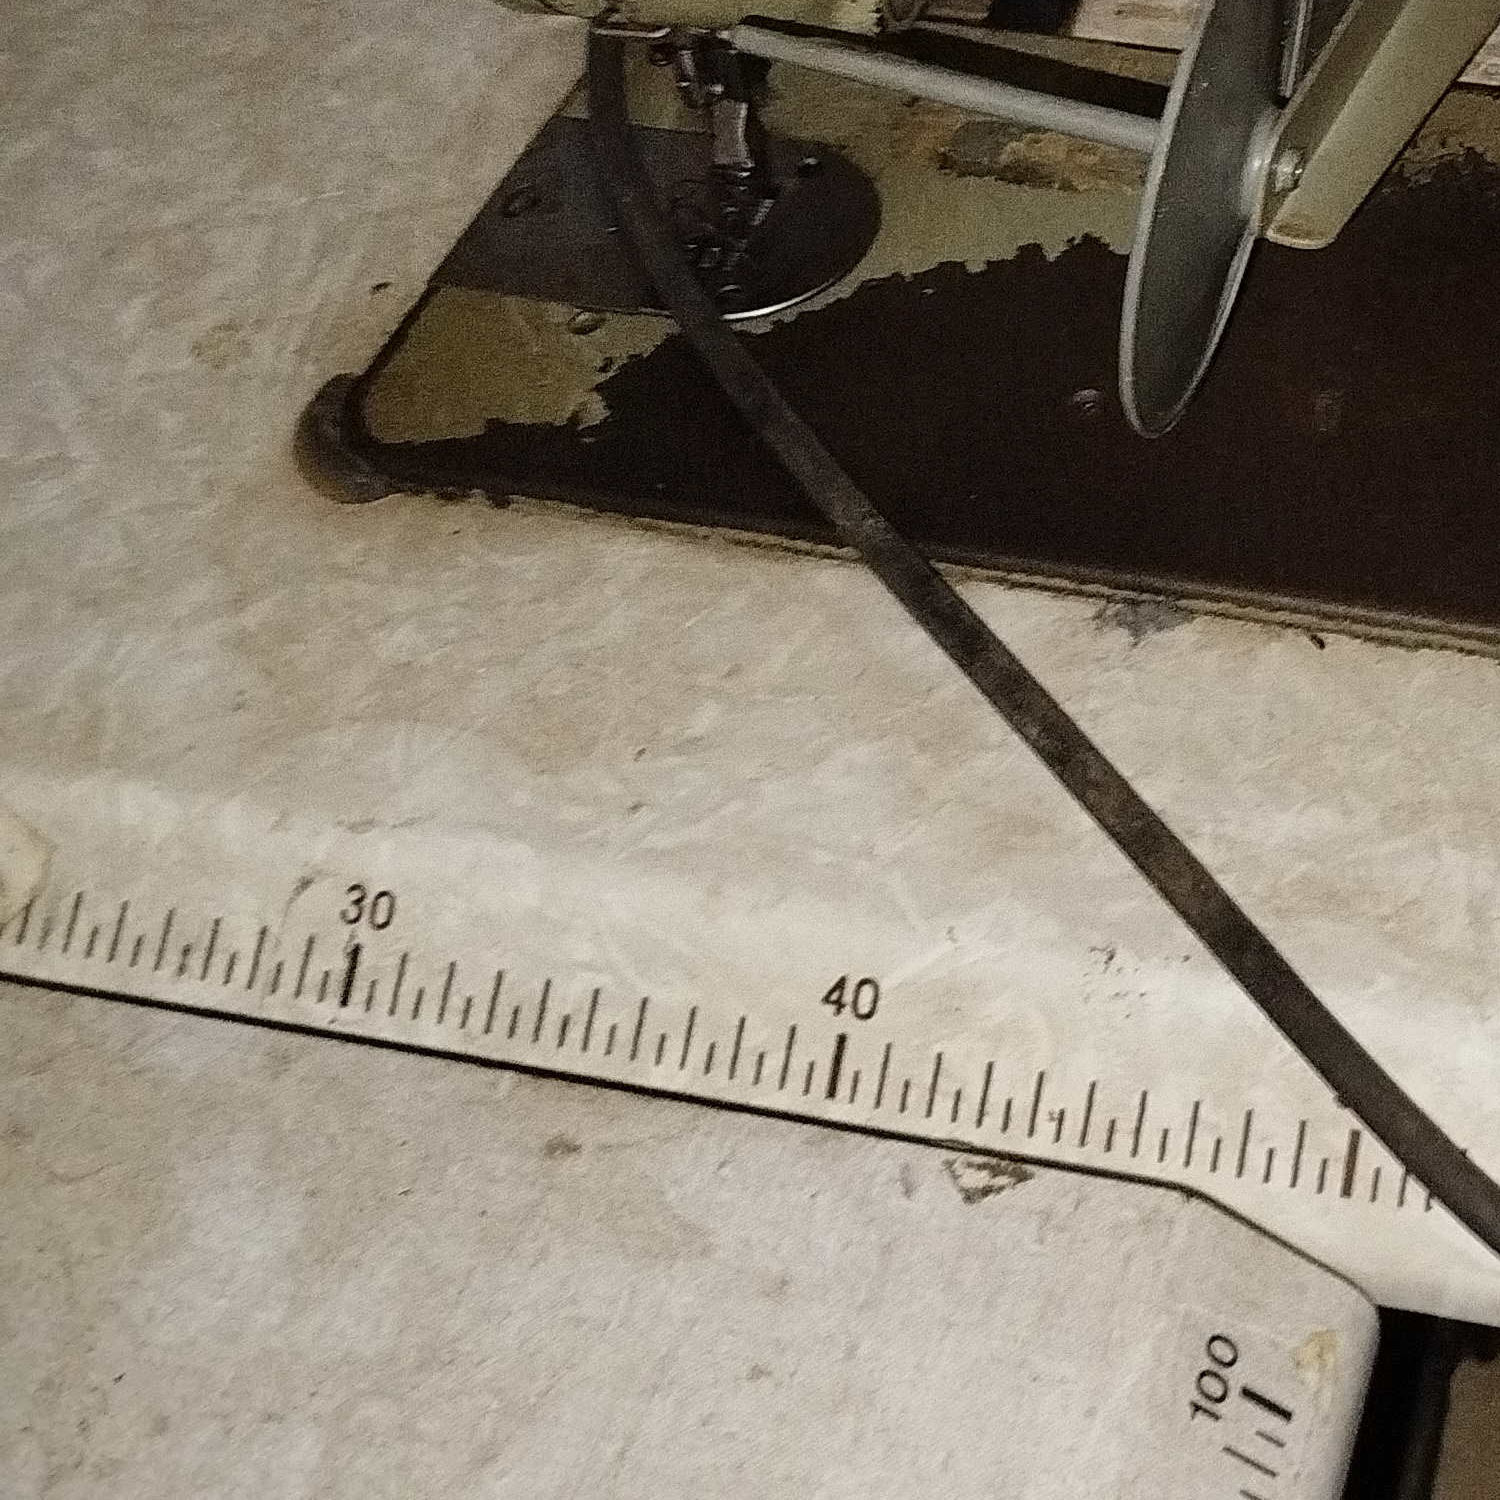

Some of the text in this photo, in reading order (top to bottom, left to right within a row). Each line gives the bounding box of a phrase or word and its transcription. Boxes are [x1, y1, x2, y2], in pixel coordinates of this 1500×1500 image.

[341, 885, 396, 931] 30
[821, 977, 879, 1020] 40
[1189, 1333, 1239, 1422] 100
